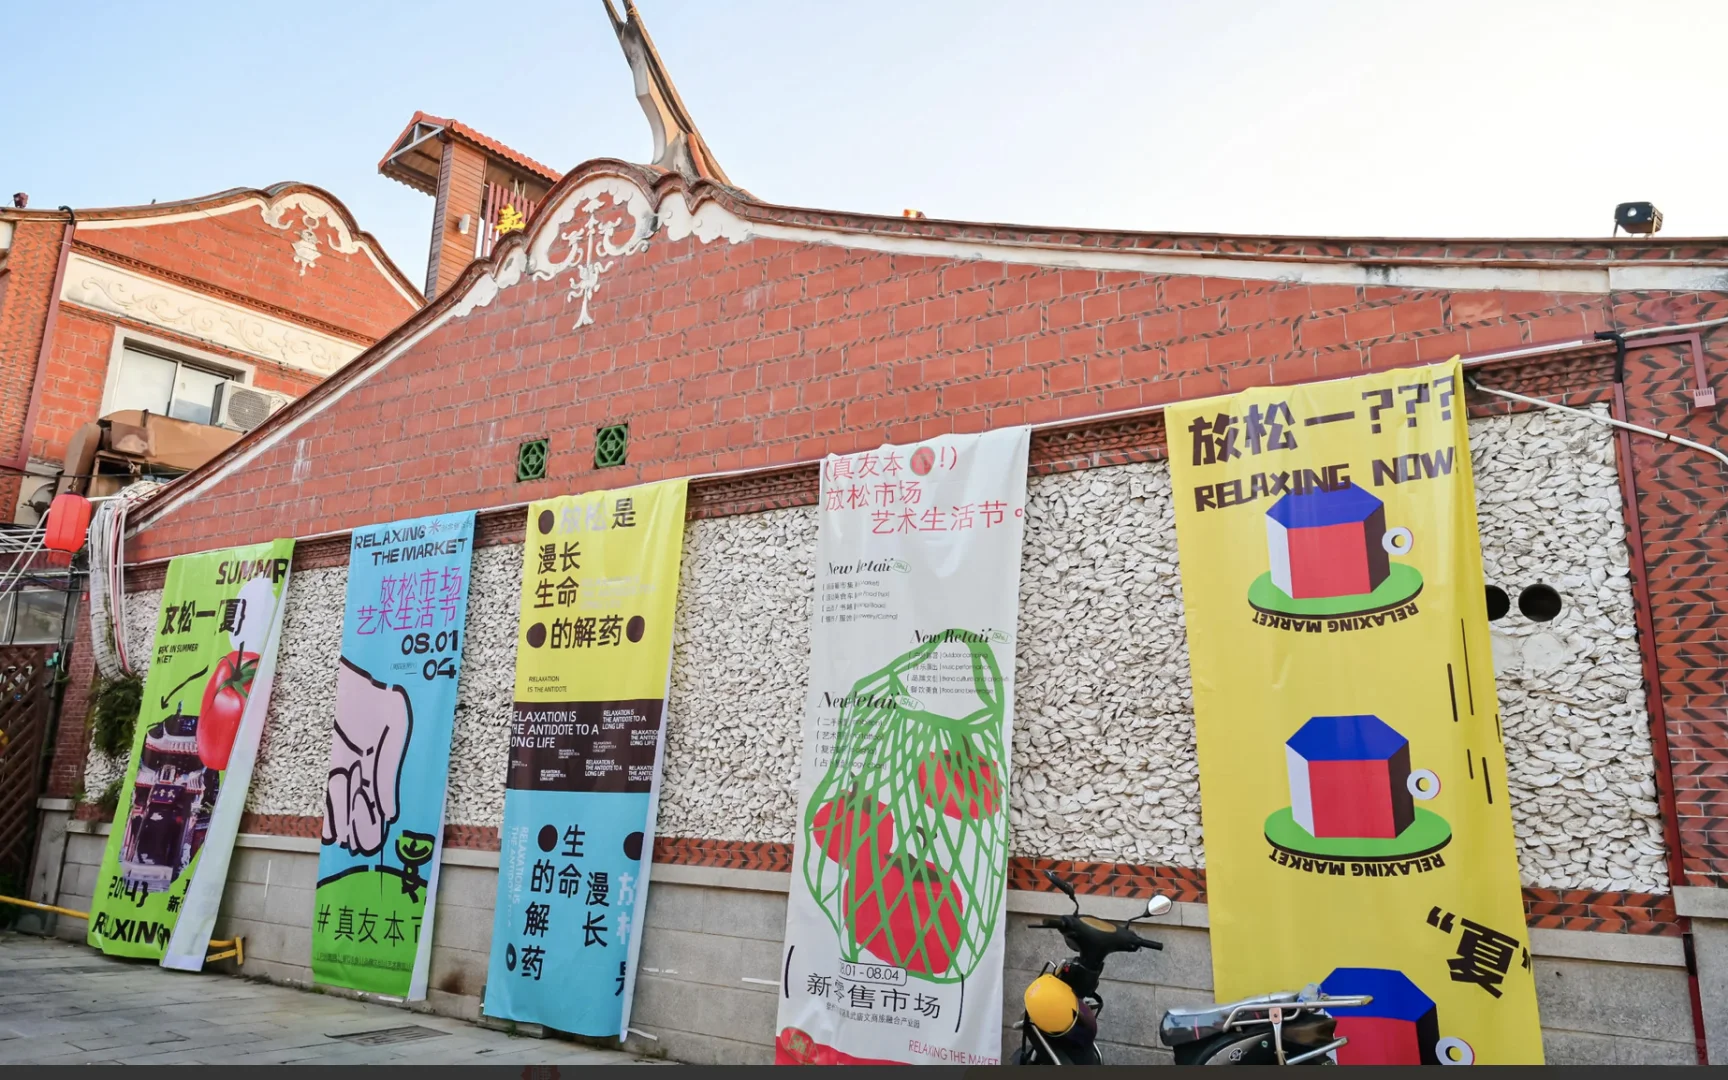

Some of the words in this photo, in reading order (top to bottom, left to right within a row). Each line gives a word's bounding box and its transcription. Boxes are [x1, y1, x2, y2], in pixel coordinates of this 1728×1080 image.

[825, 480, 922, 511] 放松市场
[1194, 463, 1351, 512] RELAXING
[558, 498, 636, 535] 放松是
[354, 525, 426, 550] RELAXING
[372, 547, 399, 566] THE
[401, 538, 468, 562] MARKET
[537, 541, 581, 575] 漫长
[381, 566, 463, 604] 放松市场
[533, 576, 579, 609] 生命
[357, 594, 461, 635] 艺术生活节
[1252, 611, 1322, 633] MARKET
[1328, 602, 1419, 633] RELAXING
[401, 630, 459, 656] 08.01
[551, 614, 624, 649] 的解药
[910, 629, 940, 643] New
[422, 657, 457, 681] 04
[513, 711, 567, 722] ELAXATION
[569, 711, 577, 722] IS
[527, 724, 573, 735] ANTIDOTE
[576, 724, 589, 735] TO
[591, 724, 599, 735] A
[511, 737, 534, 748] ONG
[537, 737, 555, 748] LIFE
[511, 826, 519, 846] THE
[514, 826, 529, 892] RELAXATION
[558, 824, 586, 898] 生命
[1268, 849, 1345, 877] MARKET
[1353, 853, 1446, 877] RELAXING
[520, 859, 555, 981] 的解药
[582, 871, 611, 948] 漫长
[866, 966, 900, 981] 08.04
[806, 972, 941, 1019] 新零售市场
[908, 1040, 949, 1061] RELAXING
[949, 1050, 966, 1064] THE
